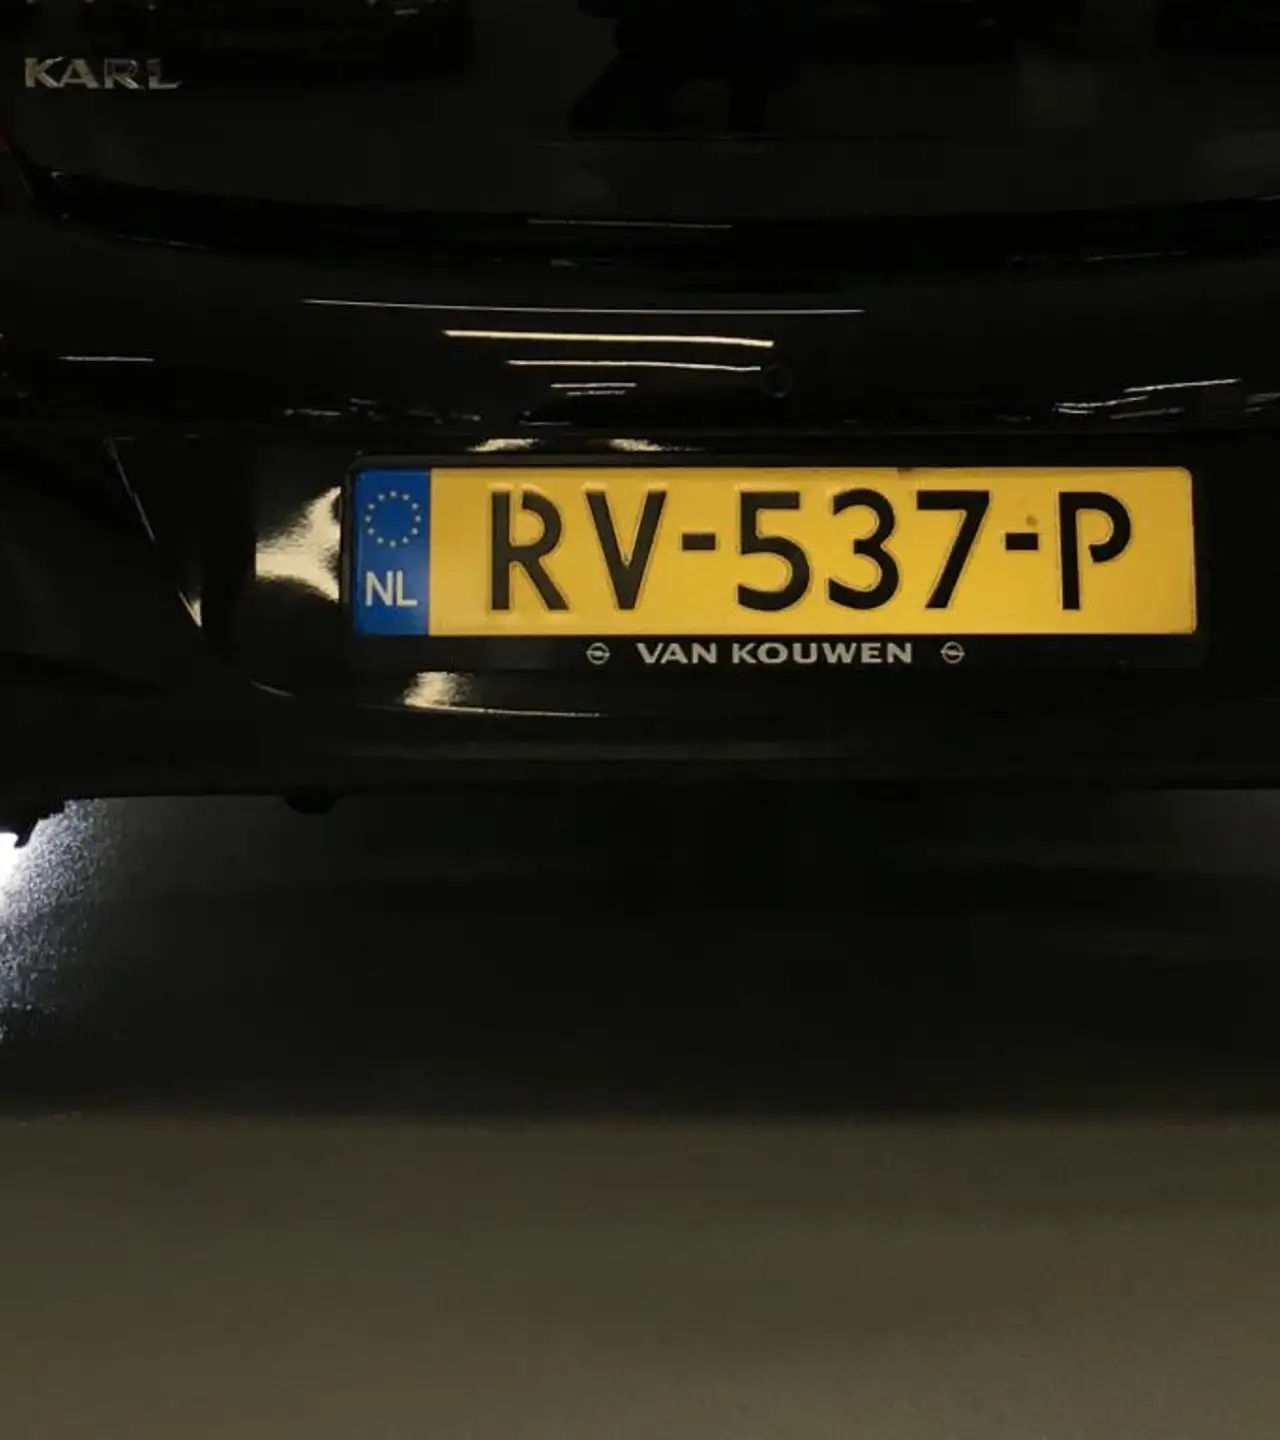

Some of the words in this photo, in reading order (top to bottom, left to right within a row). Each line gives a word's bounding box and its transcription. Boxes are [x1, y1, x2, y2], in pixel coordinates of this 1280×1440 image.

[24, 55, 183, 90] KARL
[491, 488, 1131, 612] RV-537-P
[365, 570, 419, 607] NL
[636, 642, 718, 664] VAN
[731, 642, 913, 664] KOUWEN
